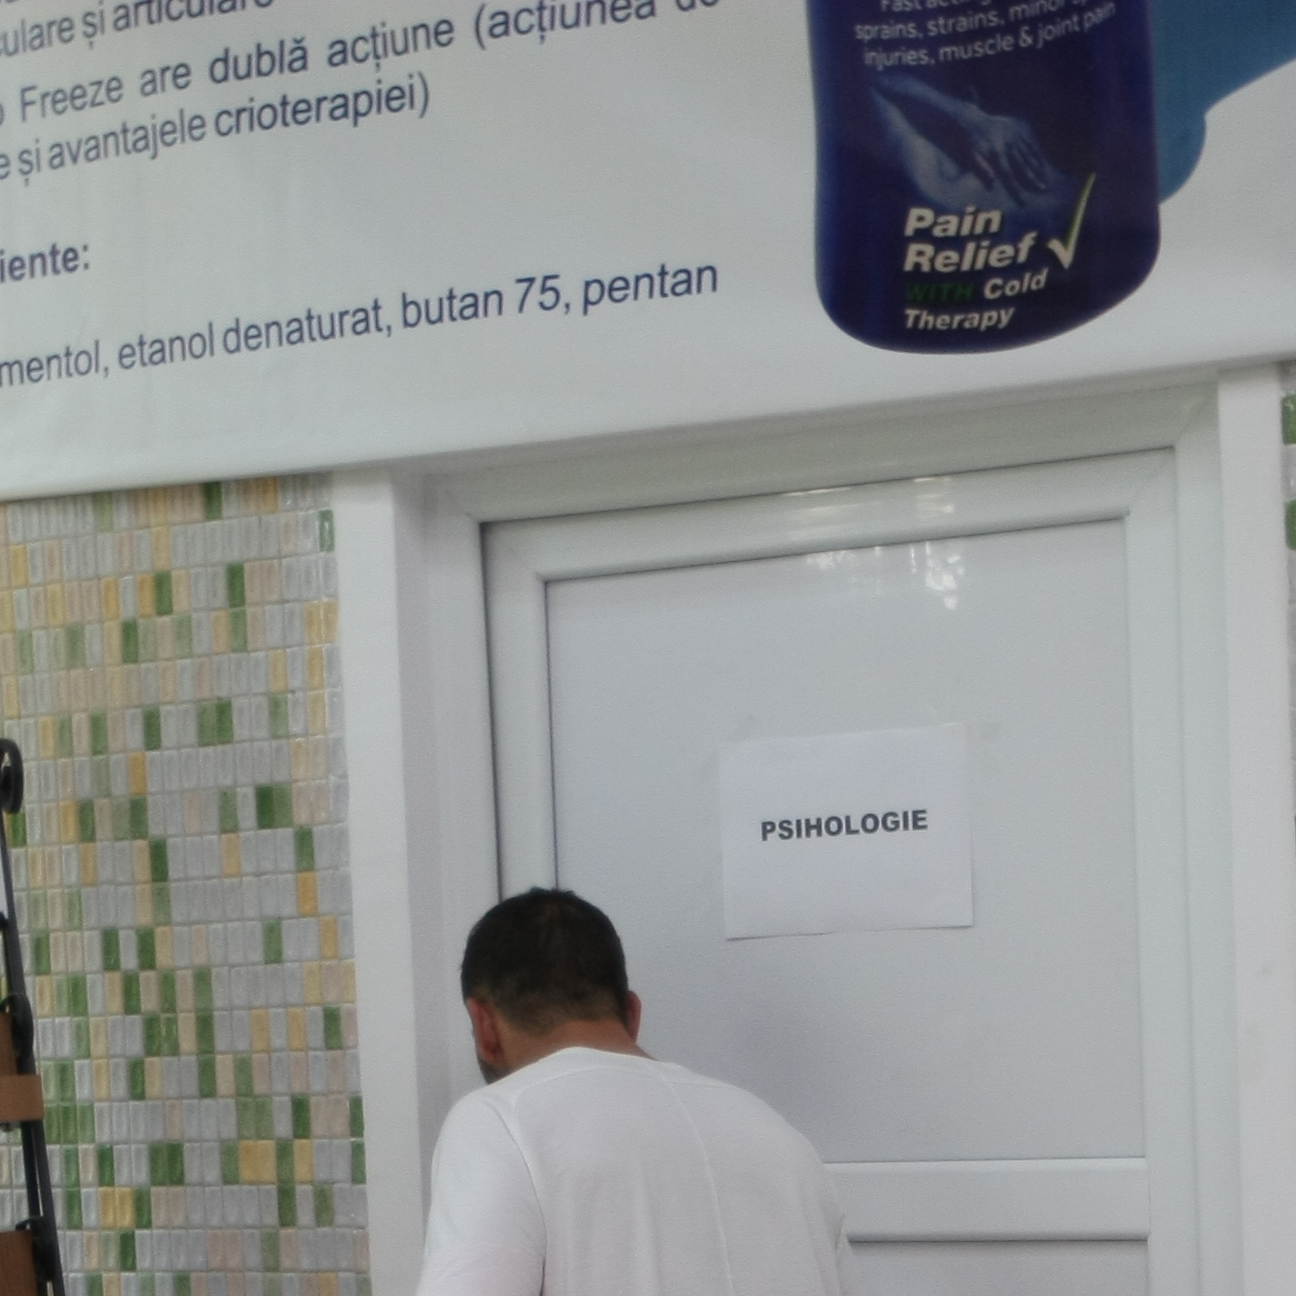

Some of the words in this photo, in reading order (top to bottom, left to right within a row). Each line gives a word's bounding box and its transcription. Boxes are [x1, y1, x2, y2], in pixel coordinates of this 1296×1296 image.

[926, 10, 1005, 37] strains,
[938, 34, 1015, 63] muscle
[1017, 26, 1034, 48] &
[1036, 14, 1081, 50] joint
[20, 74, 124, 122] Freeze
[140, 62, 192, 97] are
[209, 36, 309, 85] dublă
[327, 17, 455, 70] acțiune
[49, 108, 207, 161] avantajele
[214, 71, 431, 138] crioterapiei)
[904, 205, 1002, 238] Pain
[903, 231, 1039, 273] Relief
[906, 281, 975, 301] WITH
[983, 267, 1049, 300] Cold
[118, 322, 216, 371] etanol
[223, 296, 393, 354] denaturat,
[402, 286, 504, 329] butan
[515, 274, 571, 315] 75,
[582, 262, 719, 317] pentan
[904, 307, 1016, 332] Therapy
[760, 809, 928, 842] PSIHOLOGIE
